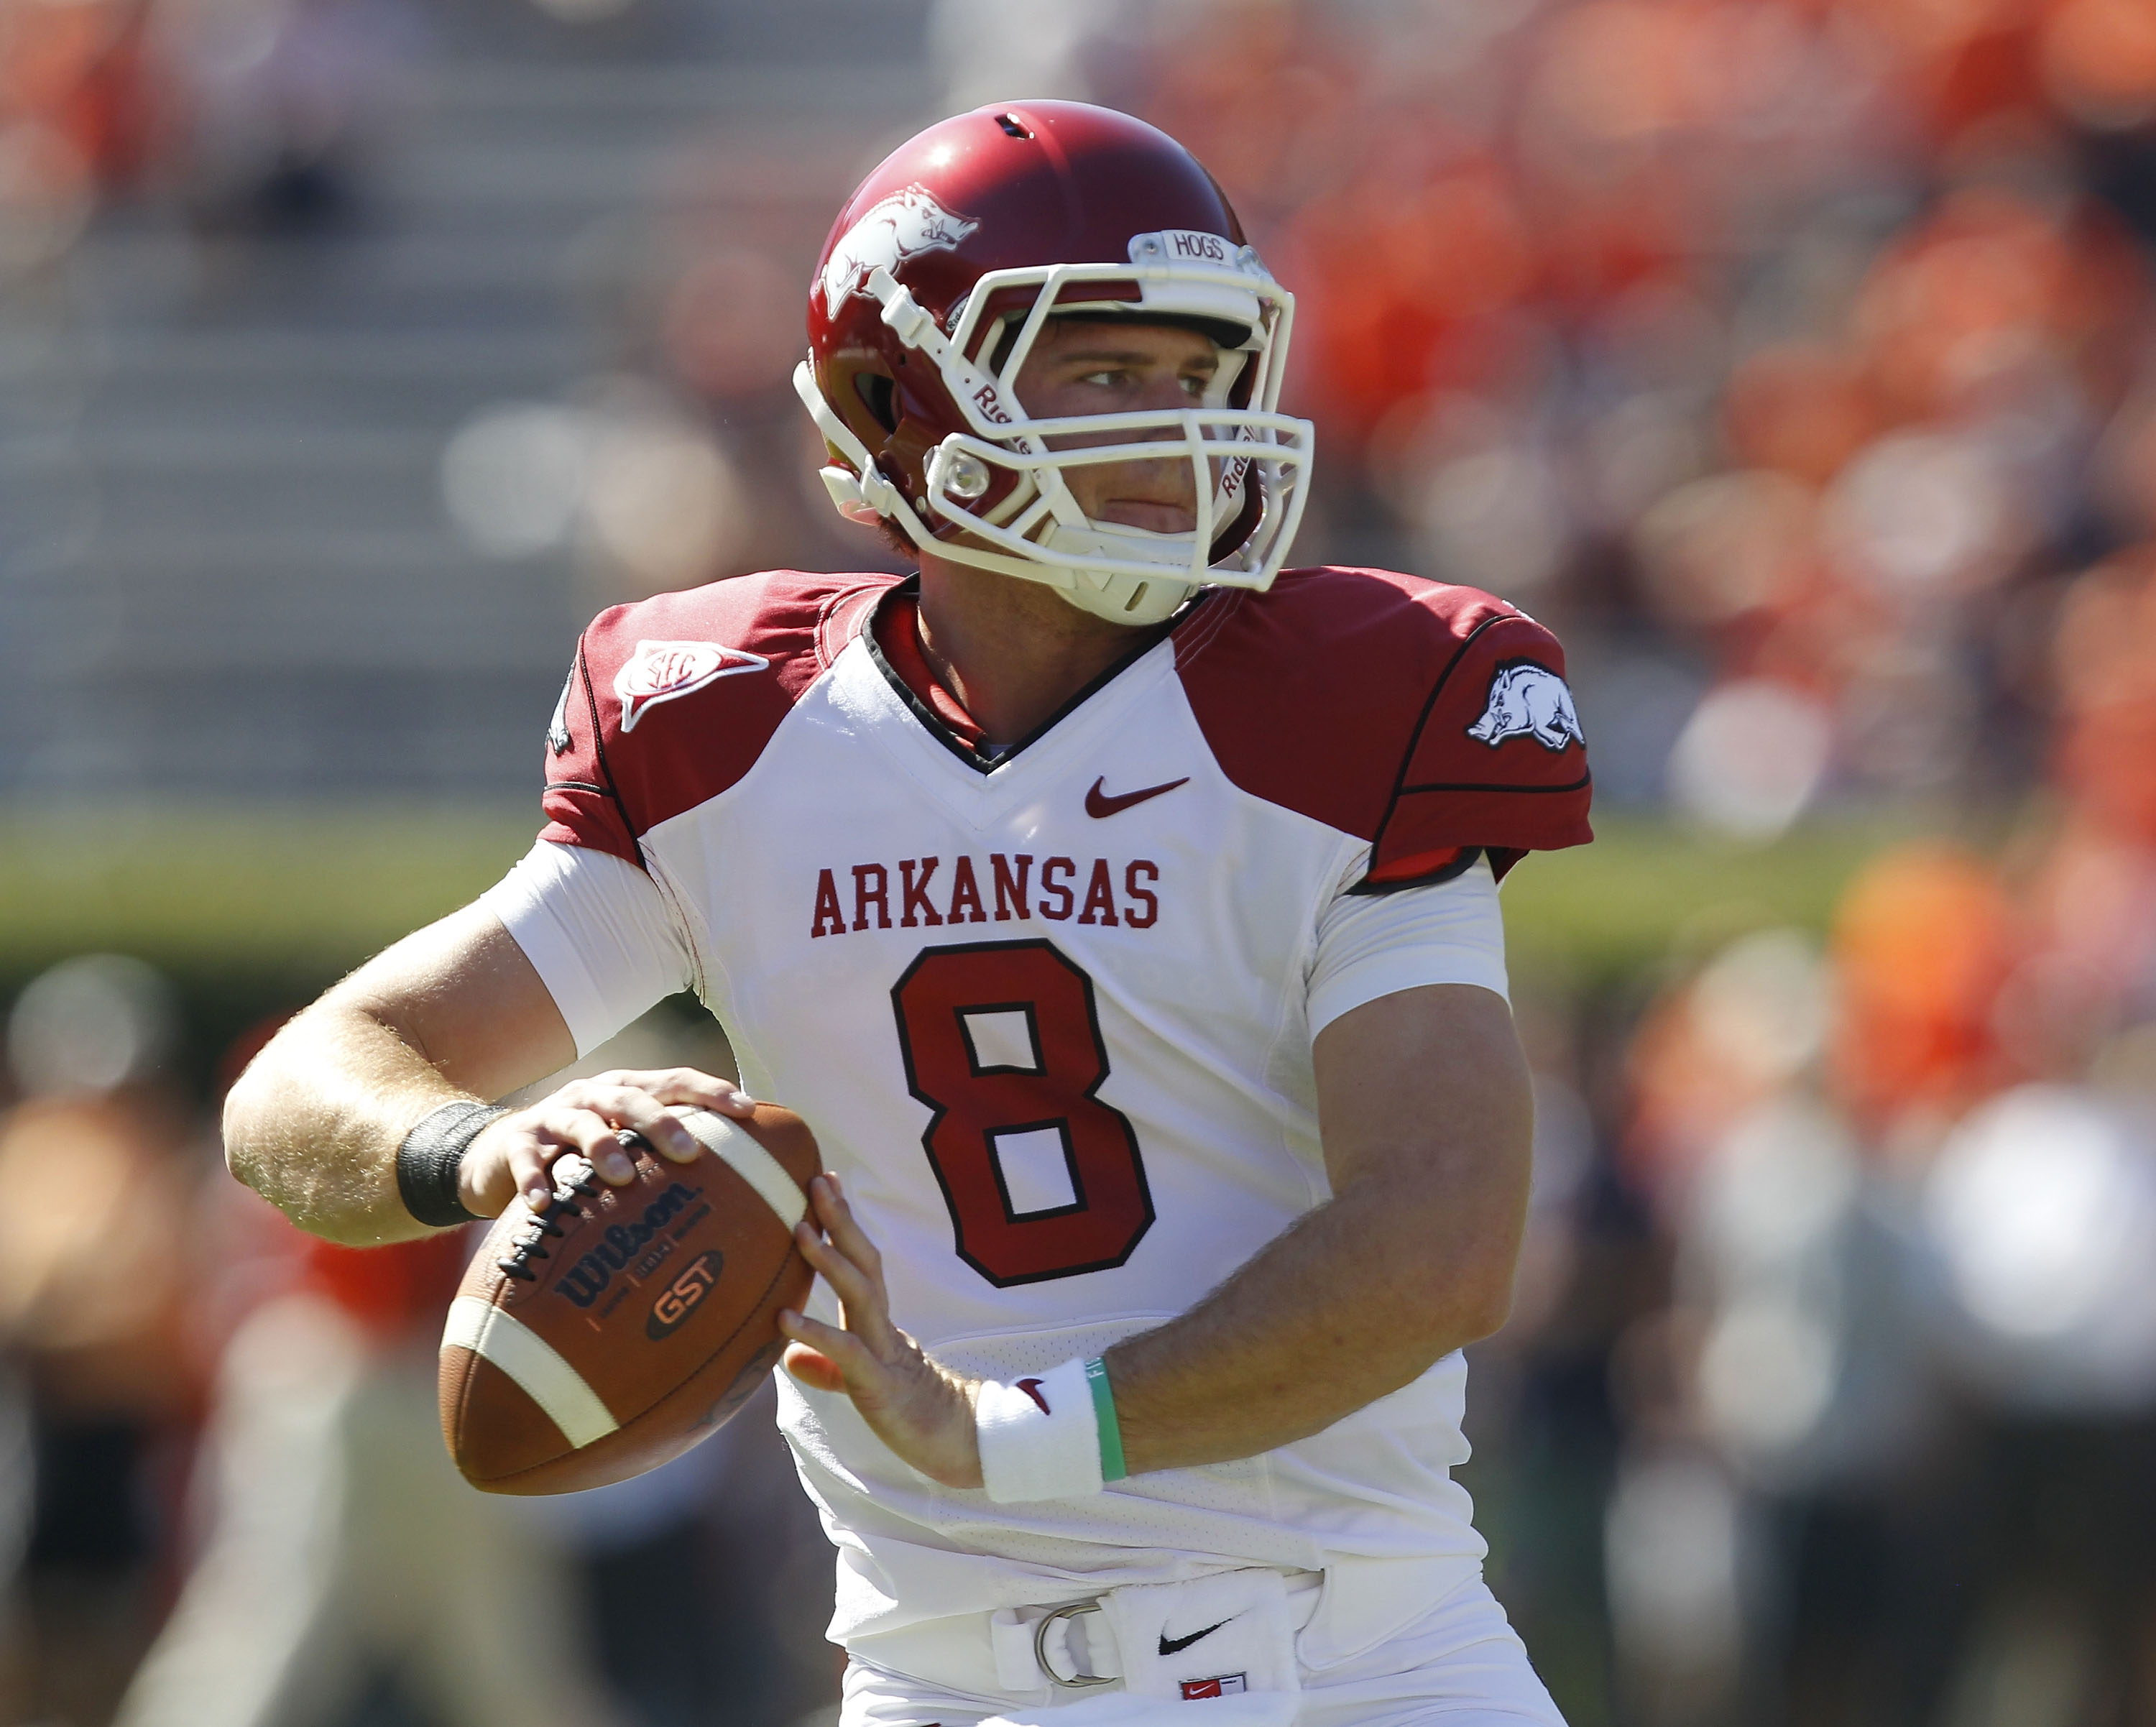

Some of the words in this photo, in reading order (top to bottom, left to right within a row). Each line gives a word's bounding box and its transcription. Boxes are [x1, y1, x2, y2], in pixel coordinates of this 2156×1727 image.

[1173, 234, 1224, 260] HOGS
[811, 853, 1159, 938] ARKANSAS
[890, 938, 1156, 1289] 8
[553, 1182, 701, 1308] Wilson
[653, 1255, 715, 1324] GST
